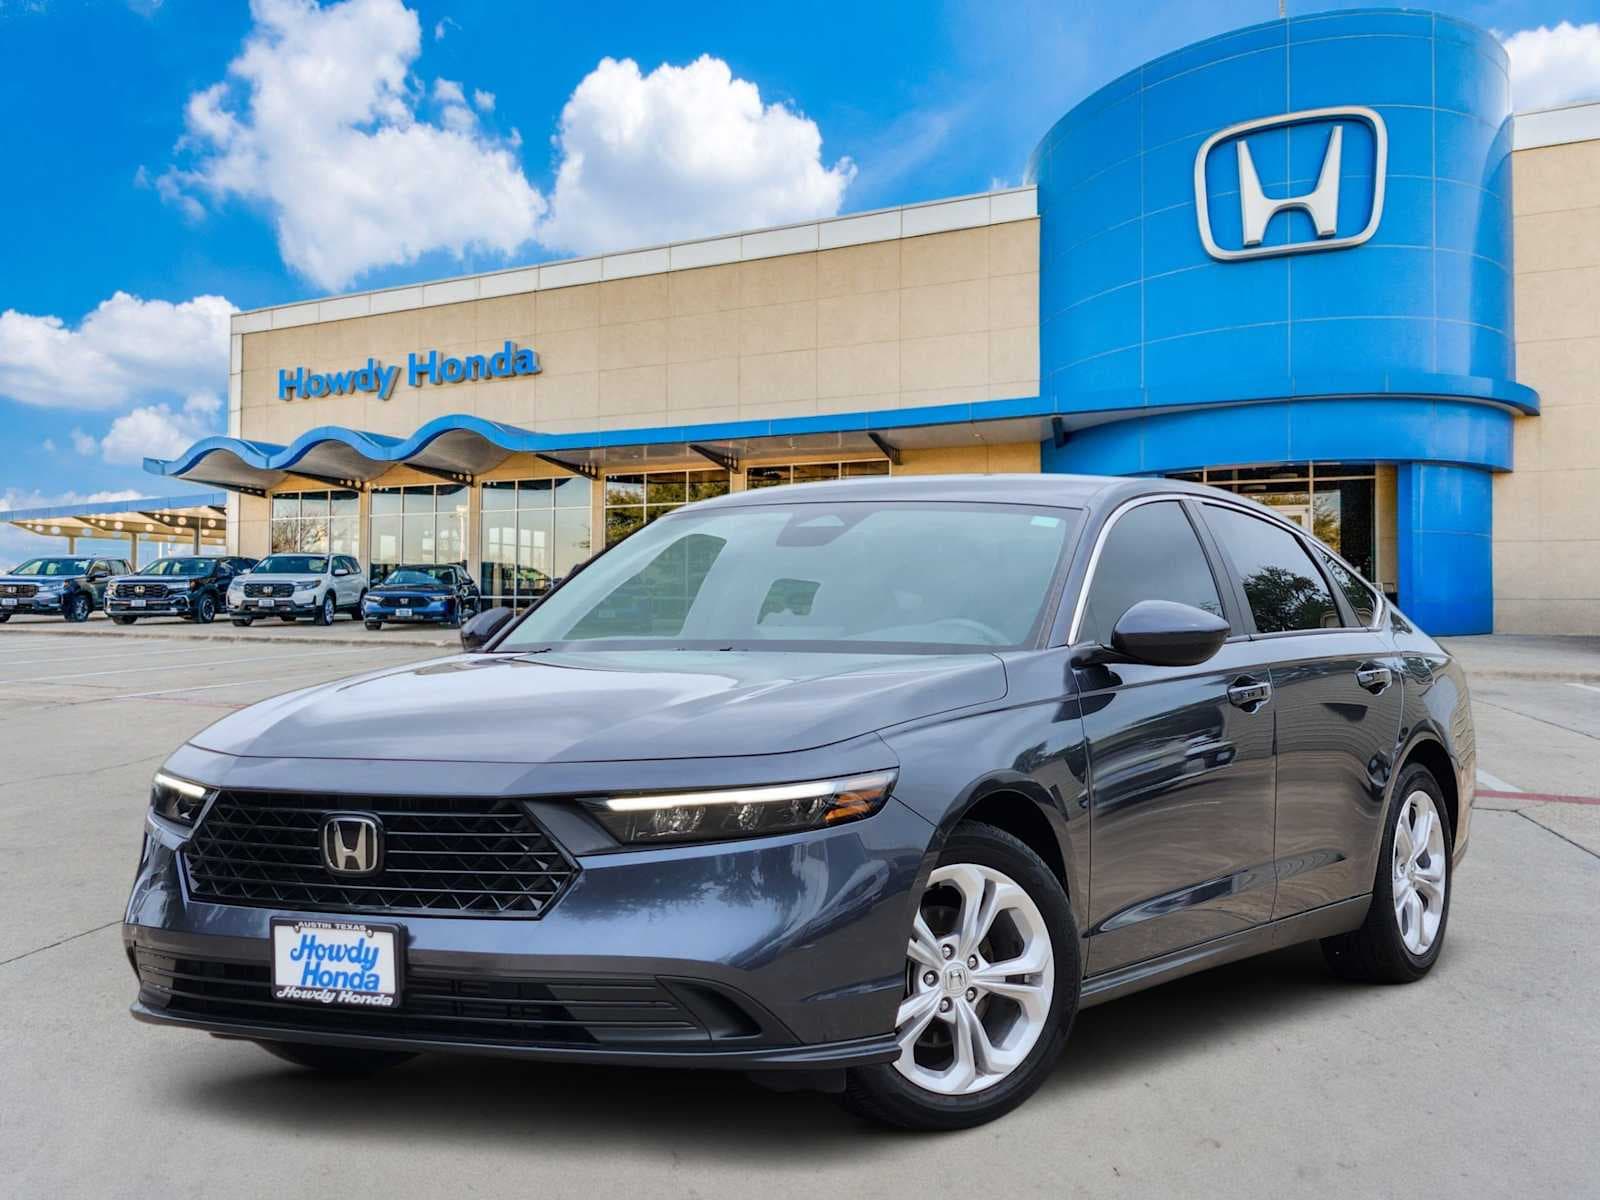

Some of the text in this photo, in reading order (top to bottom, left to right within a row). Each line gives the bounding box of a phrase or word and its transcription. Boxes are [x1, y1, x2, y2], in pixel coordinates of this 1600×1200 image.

[278, 340, 541, 401] Howdy Honda
[298, 921, 366, 931] AUSTIN TEXAS
[290, 934, 380, 971] Howdy
[301, 961, 380, 991] Honda
[276, 985, 394, 1006] Howdy Honda
